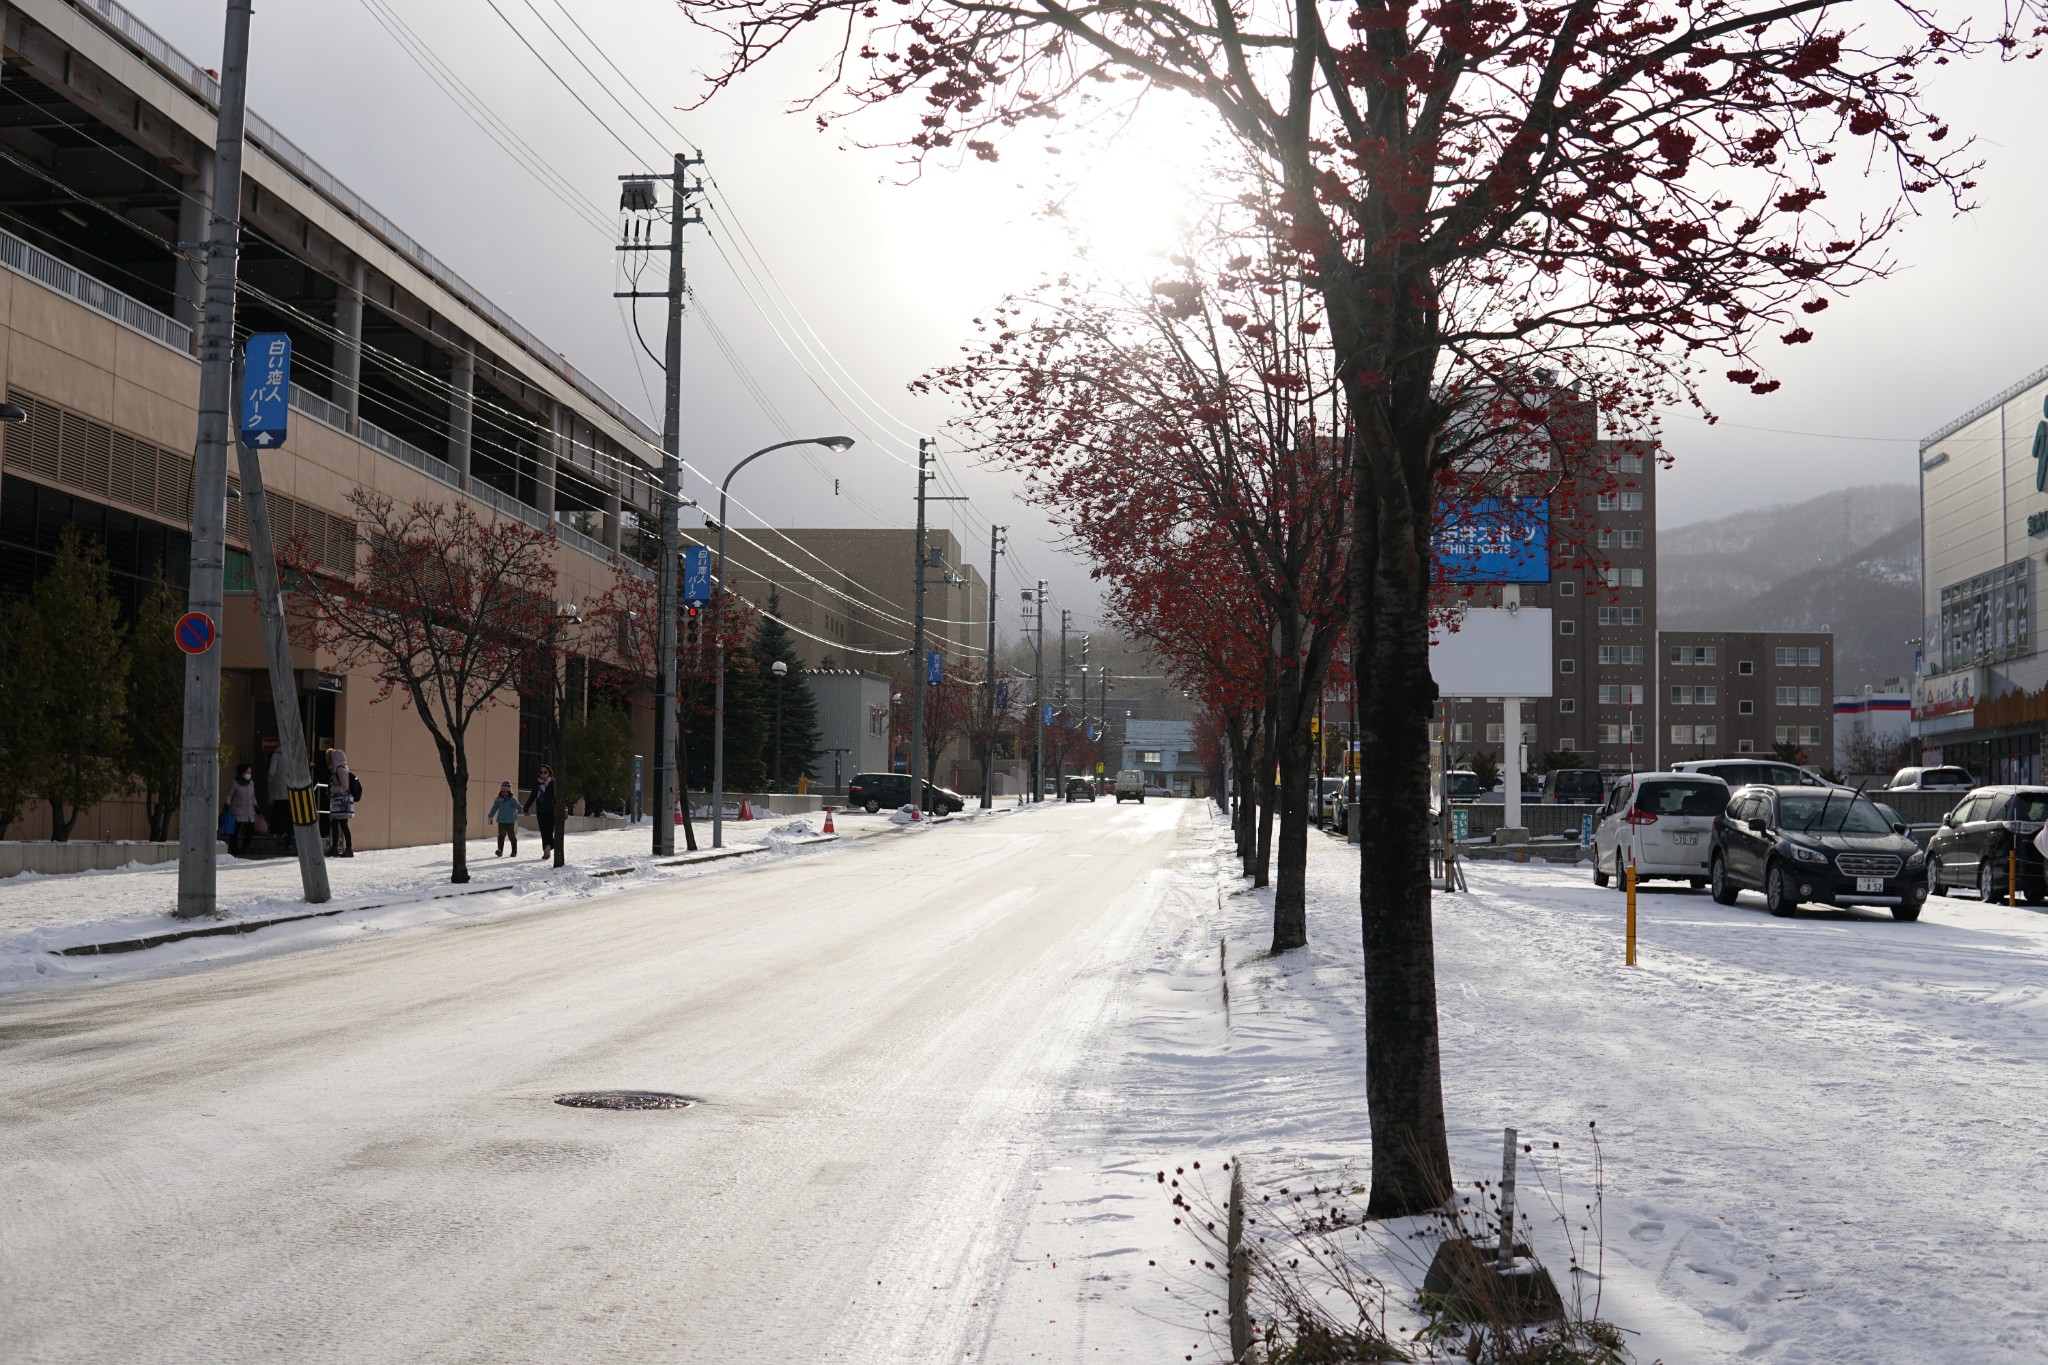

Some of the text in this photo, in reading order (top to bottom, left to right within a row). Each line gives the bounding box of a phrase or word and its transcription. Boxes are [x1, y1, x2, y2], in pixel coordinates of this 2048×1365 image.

[265, 340, 286, 402] 白い恋人
[249, 387, 267, 428] パーク
[697, 549, 708, 584] 白い恋人
[1468, 544, 1511, 555] SPORTS
[688, 575, 698, 598] パーク
[1943, 588, 2028, 634] ジュニアスクール
